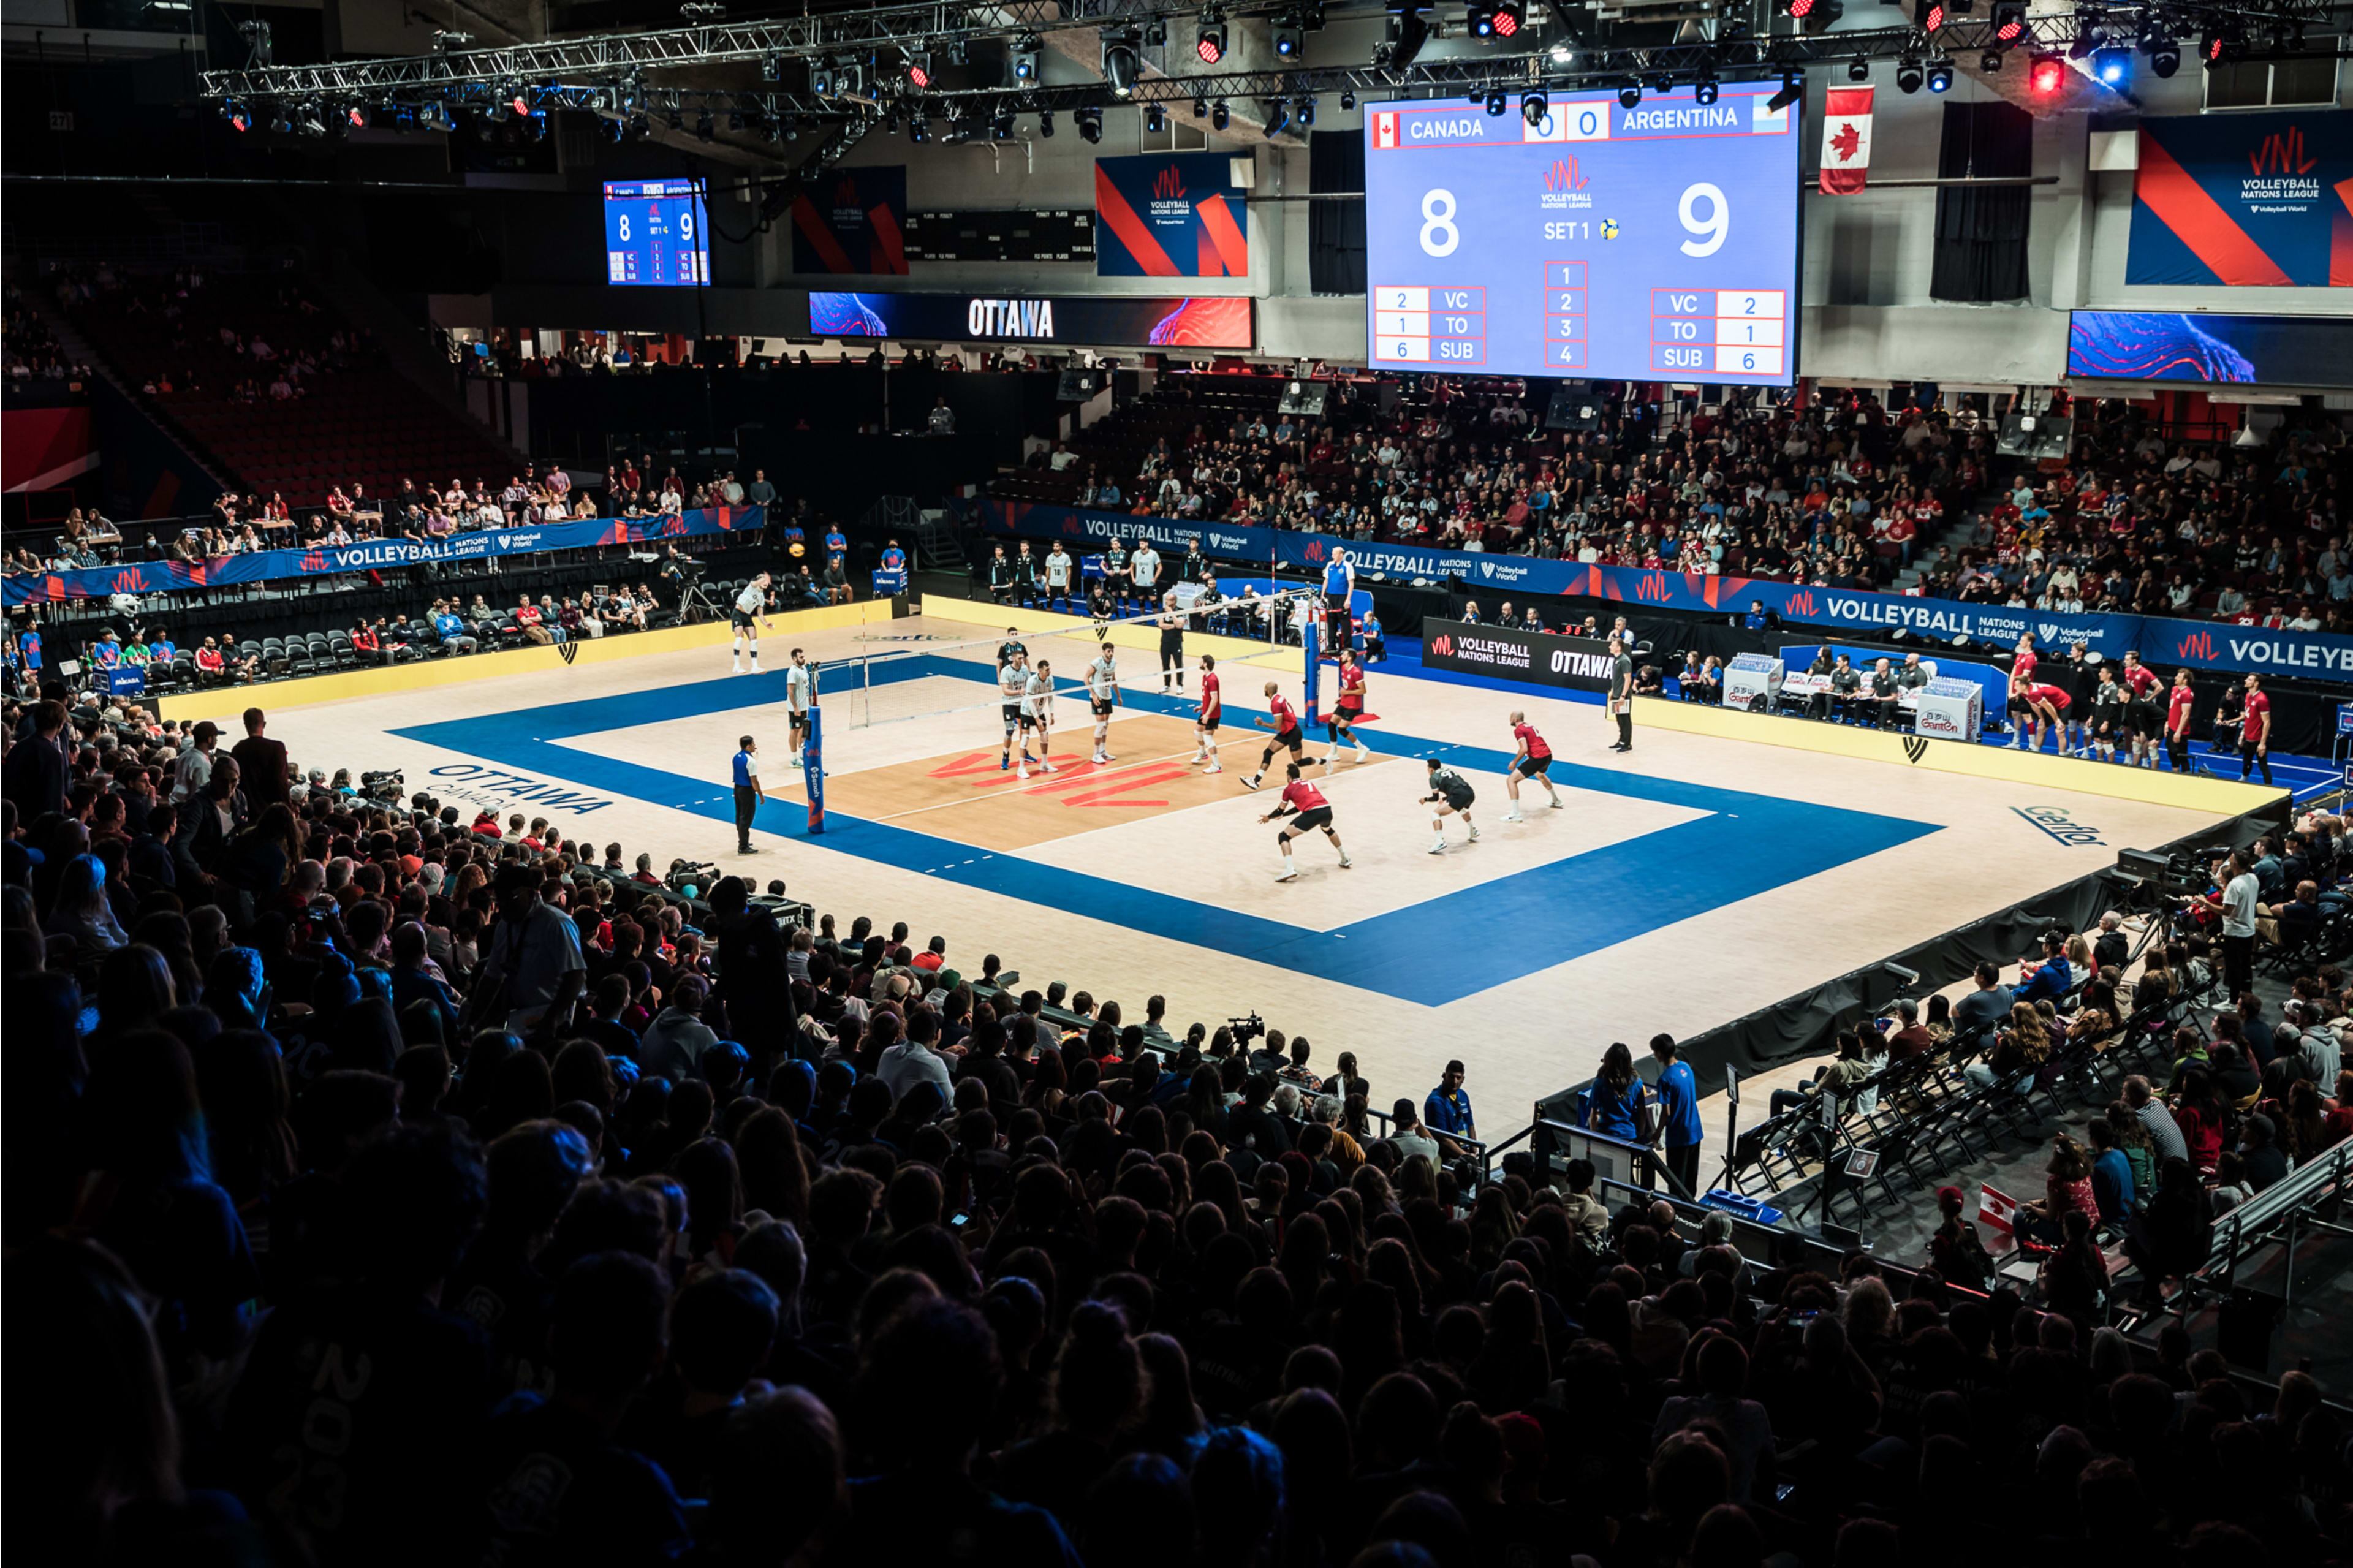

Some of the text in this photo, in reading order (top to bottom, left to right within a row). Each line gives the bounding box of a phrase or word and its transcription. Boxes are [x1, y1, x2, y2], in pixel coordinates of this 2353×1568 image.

[1411, 119, 1483, 139] CANADA
[1579, 111, 1597, 136] 0
[1623, 108, 1738, 131] ARGENTINA
[2249, 126, 2318, 176] VNL
[1152, 163, 1188, 199] VNL
[1543, 154, 1590, 191] VNL
[2242, 178, 2319, 190] VOLLEYBALL
[1540, 193, 1592, 203] VOLLEYBALL
[2241, 189, 2319, 199] NATIONS LEAGUE
[2259, 205, 2287, 214] Volleyball
[619, 214, 631, 241] 8
[680, 213, 694, 240] 9
[1419, 188, 1460, 258] 8
[1678, 183, 1729, 258] 9
[1544, 222, 1589, 240] SET 1
[1562, 268, 1570, 284] 1
[1398, 292, 1468, 309] 2 VC
[1561, 294, 1571, 311] 2
[1670, 295, 1756, 315] VC 2
[968, 299, 1053, 338] OTTAWA
[1399, 317, 1468, 334] 1 TO
[1561, 320, 1571, 336] 3
[1671, 322, 1753, 342] TO 1
[1398, 342, 1474, 360] 6 SUB
[1560, 346, 1571, 363] 4
[1664, 349, 1754, 370] SUB 6
[512, 532, 542, 543] Volleyball
[1085, 519, 1173, 544] VOLLEYBALL
[1173, 528, 1202, 540] NATIONS
[1221, 534, 1248, 545] Volleyball
[455, 536, 490, 548] NATIONS
[455, 543, 486, 556] LEAGUE
[512, 539, 534, 548] World
[1221, 541, 1240, 551] World
[299, 536, 454, 573] VNL VOLLEYBALL
[1343, 550, 1435, 575] OLLEYBALL
[1439, 559, 1471, 570] NATIONS
[1496, 564, 1528, 576] Volleyball
[112, 566, 150, 593] VNL
[1496, 572, 1517, 581] World
[1635, 571, 1673, 602] VNL
[1785, 590, 1974, 635] VNL VOLLEYBALL
[1978, 616, 2026, 631] NATIONS
[2059, 626, 2104, 639] Volleyball
[1977, 626, 2019, 640] LEAGUE
[1431, 634, 1455, 657] VNL
[1458, 636, 1531, 658] VOLLEYBALL
[2177, 631, 2220, 661] VNL
[1457, 650, 1531, 668] NATIONS LEAGUE
[428, 764, 614, 815] OTTAWA
[811, 773, 820, 798] Senoh
[426, 784, 517, 809] CANADA
